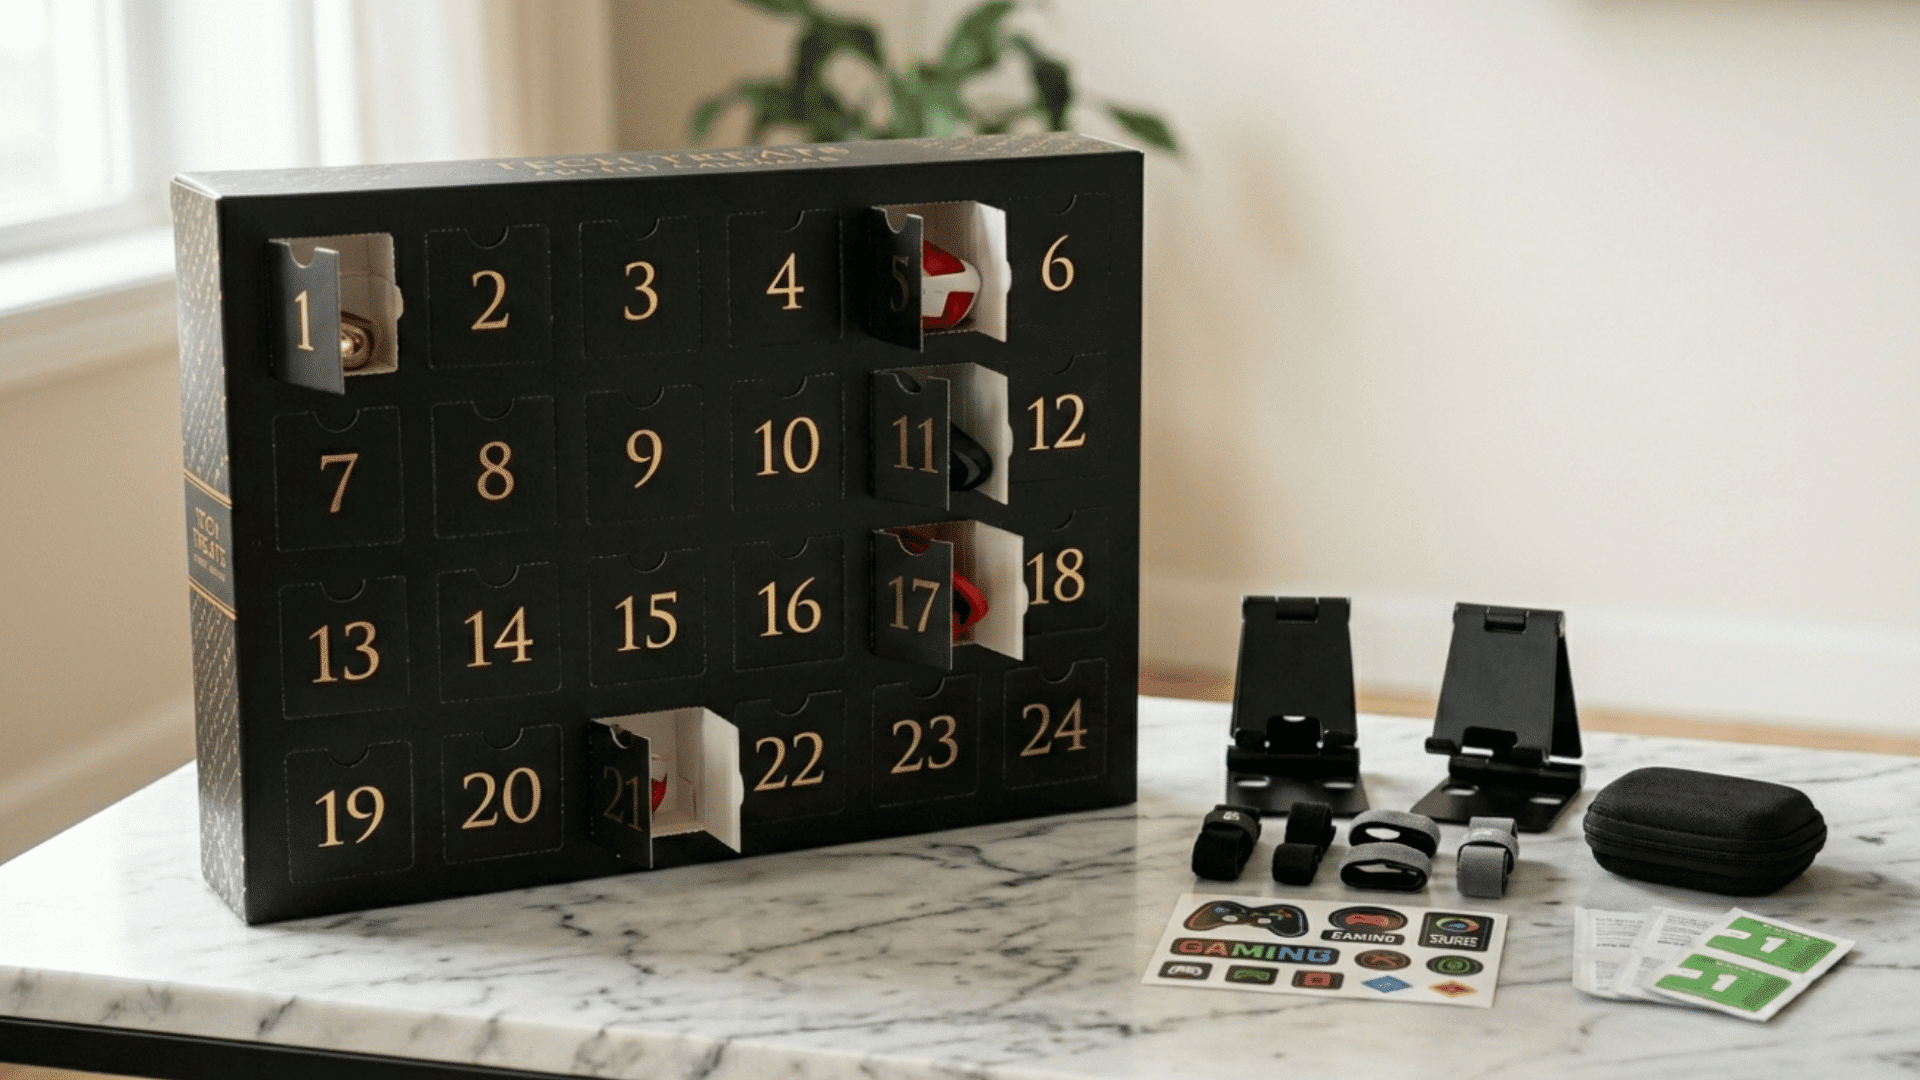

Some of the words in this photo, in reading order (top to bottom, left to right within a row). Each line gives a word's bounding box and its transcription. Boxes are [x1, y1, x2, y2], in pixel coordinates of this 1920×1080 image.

[625, 261, 658, 320] 3
[767, 253, 804, 310] 4
[890, 256, 909, 311] 5
[1042, 235, 1074, 291] 6
[294, 291, 313, 351] 1
[472, 270, 508, 330] 2
[756, 417, 819, 476] 10
[893, 415, 938, 474] 11
[1028, 394, 1085, 450] 12
[321, 453, 358, 512] 7
[478, 441, 514, 500] 8
[627, 430, 662, 488] 9
[888, 576, 941, 633] 17
[1026, 548, 1085, 605] 18
[615, 591, 677, 651] 15
[758, 577, 821, 636] 16
[310, 621, 379, 683] 13
[465, 607, 533, 667] 14
[892, 716, 957, 773] 23
[1021, 700, 1087, 756] 24
[754, 732, 823, 791] 22
[316, 786, 384, 847] 19
[463, 767, 541, 829] 20
[604, 766, 643, 832] 21
[1179, 940, 1332, 963] GAMING
